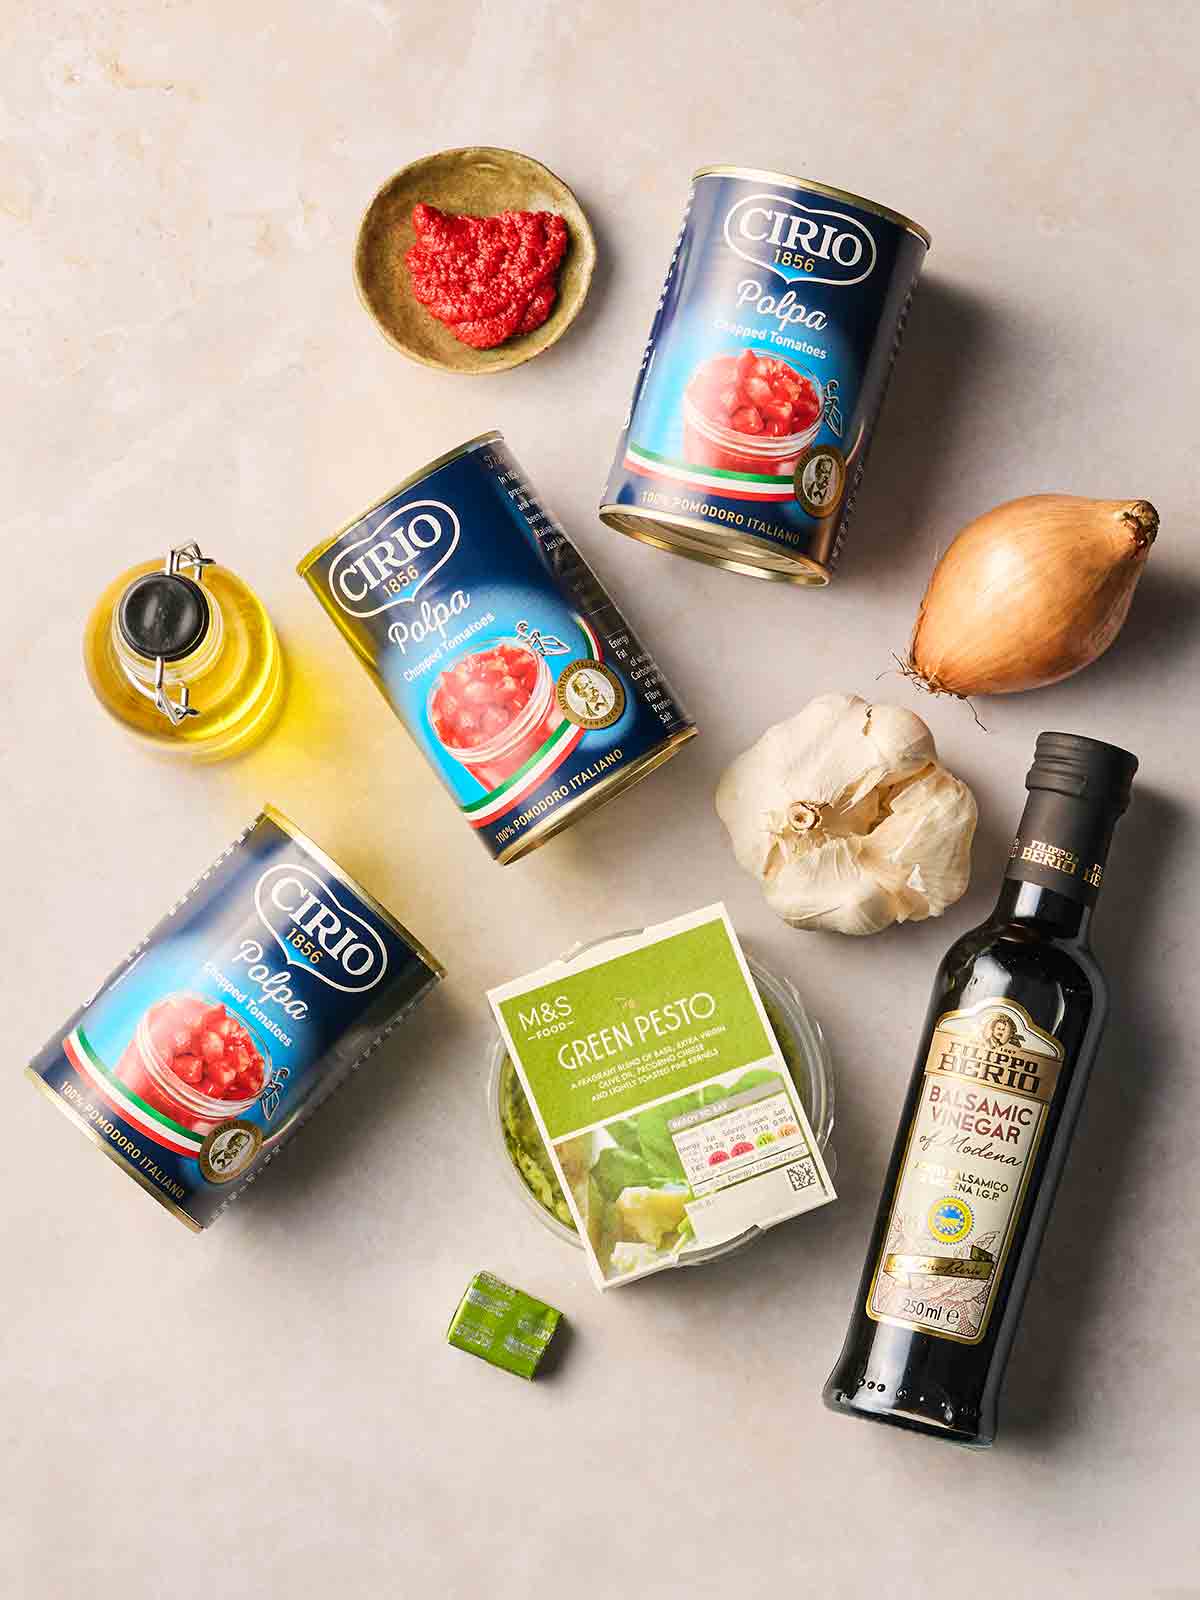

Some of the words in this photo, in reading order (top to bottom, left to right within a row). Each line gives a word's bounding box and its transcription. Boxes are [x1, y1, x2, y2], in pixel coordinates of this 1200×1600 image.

[740, 208, 863, 267] CIRIO
[774, 249, 816, 273] 1856
[736, 279, 829, 332] Polpa
[769, 331, 827, 359] Tomatoes
[671, 496, 744, 525] POMODORO
[747, 517, 800, 545] ITALIANO
[340, 514, 442, 601] CIRIO
[382, 564, 419, 599] 1856
[388, 590, 471, 655] Polpa
[403, 647, 443, 682] Chopped
[440, 611, 495, 652] Tomatoes
[659, 712, 673, 724] Salt
[496, 825, 516, 845] 100%
[513, 785, 569, 831] POMODORO
[569, 748, 623, 790] ITALIANO
[1021, 847, 1077, 874] BERIO
[1031, 839, 1073, 861] FILIPPO
[272, 878, 374, 976] CIRIO
[286, 927, 323, 964] 1856
[232, 939, 309, 1021] Polpa
[246, 1000, 292, 1047] Tomatoes
[518, 995, 572, 1032] M&S
[537, 1021, 567, 1040] FOOD
[558, 1022, 633, 1070] GREEN
[634, 992, 715, 1043] PESTO
[937, 1053, 1041, 1094] BERIO
[949, 1041, 1039, 1074] FILIPPO
[929, 1085, 1034, 1126] BALSAMIC
[932, 1105, 1021, 1145] VINEGAR
[85, 1103, 141, 1159] POMODORO
[139, 1156, 186, 1200] ITALIANO
[919, 1128, 942, 1152] of
[942, 1133, 1022, 1167] Modena
